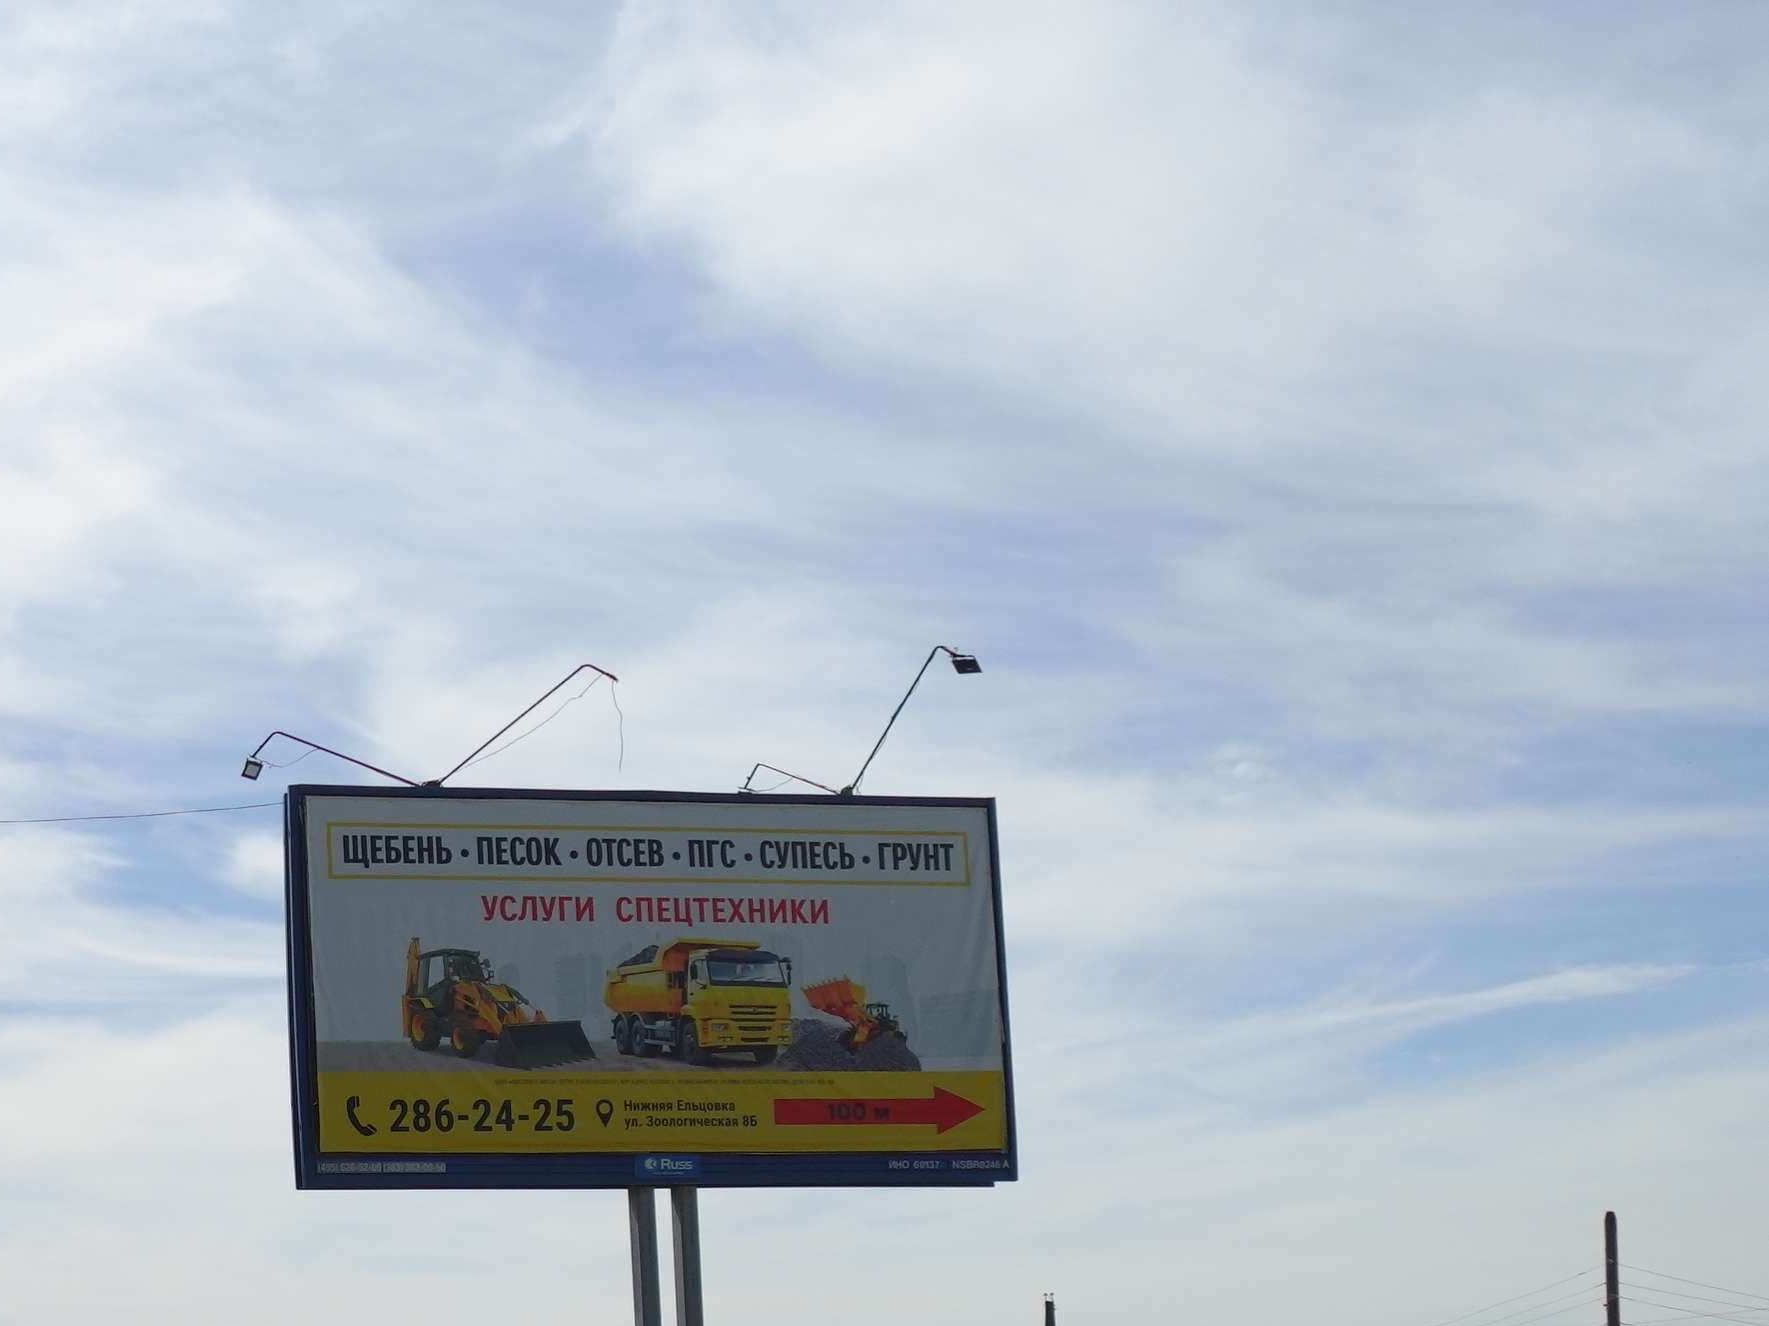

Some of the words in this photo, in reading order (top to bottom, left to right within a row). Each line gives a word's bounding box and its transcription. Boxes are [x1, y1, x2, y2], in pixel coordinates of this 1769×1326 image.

[342, 834, 453, 868] ЩЕБЕНЬ
[476, 836, 563, 866] ПЕСОК
[585, 838, 665, 868] ОТСЕВ
[687, 839, 736, 868] ПГС
[759, 840, 856, 870] СУПЕСЬ
[877, 842, 955, 871] ГРУНТ
[480, 895, 596, 922] УСЛУГИ
[615, 896, 831, 927] СПЕЦТЕХНИКИ
[623, 1099, 673, 1112] Нижняя
[676, 1099, 736, 1113] Ельцовка
[828, 1103, 866, 1121] 100
[388, 1098, 575, 1133] 286-24-25
[623, 1115, 643, 1130] ул.
[646, 1115, 739, 1128] Зоологическая
[742, 1114, 758, 1128] 8Б
[660, 1158, 694, 1170] Russ
